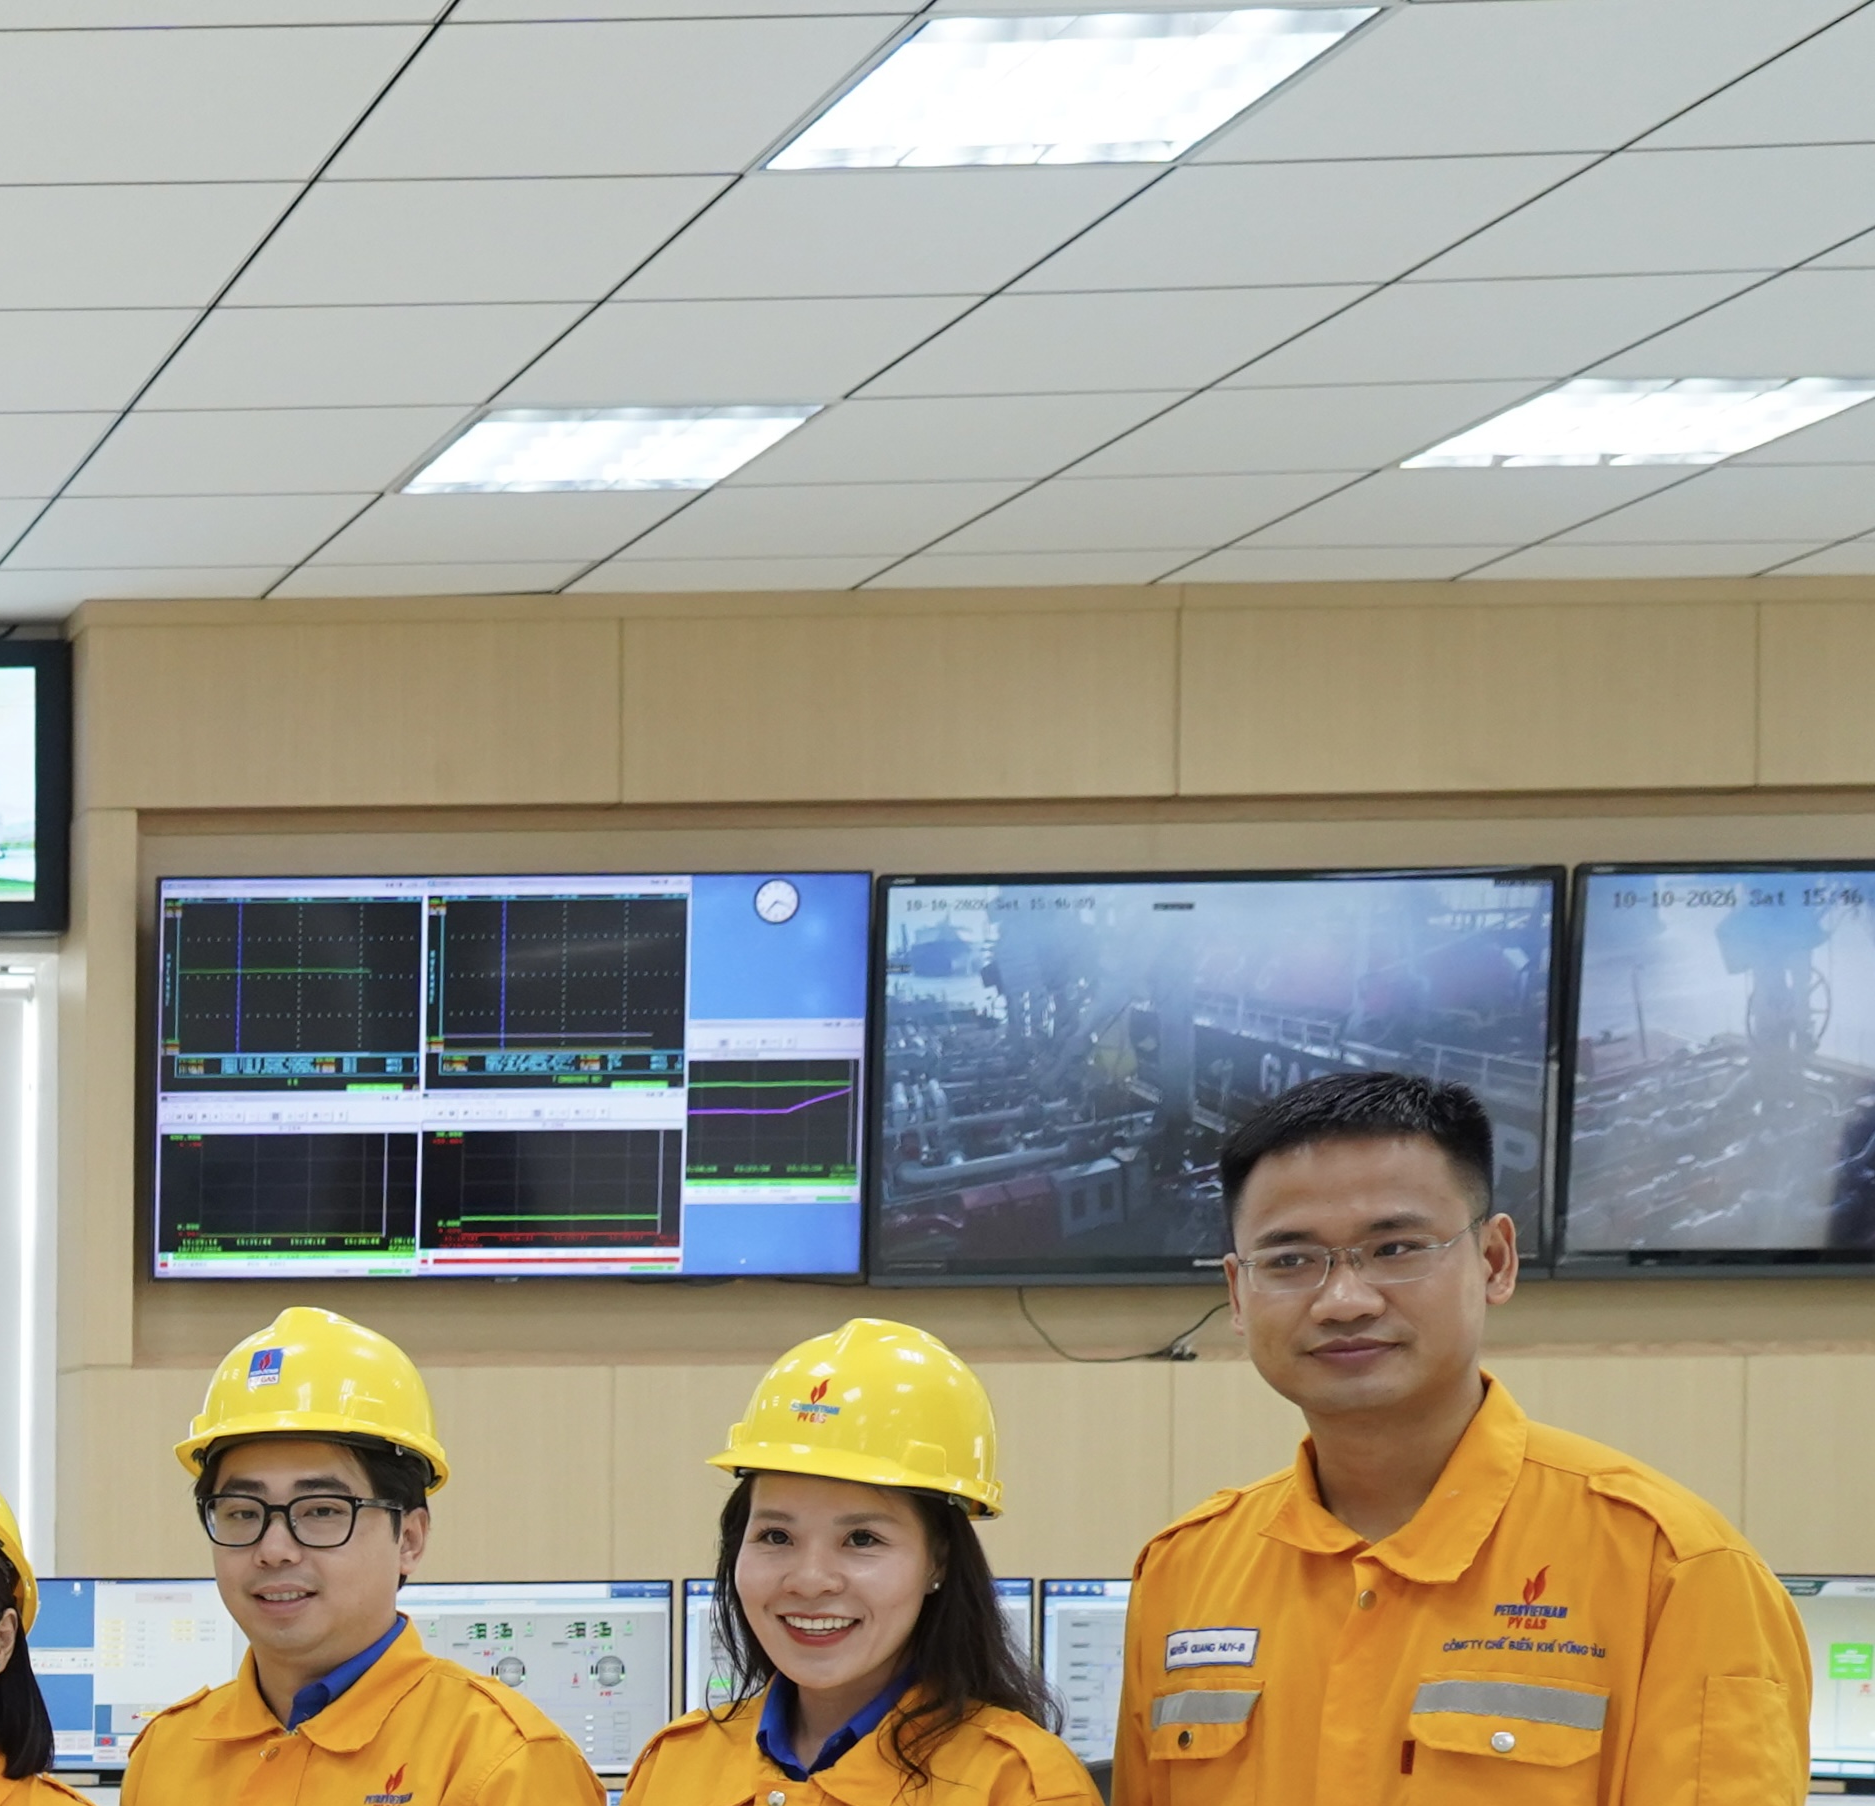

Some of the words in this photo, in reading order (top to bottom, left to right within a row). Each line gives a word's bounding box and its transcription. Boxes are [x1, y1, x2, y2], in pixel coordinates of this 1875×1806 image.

[797, 1411, 809, 1421] PV
[809, 1413, 828, 1424] GAS
[1506, 1617, 1523, 1629] PV
[1524, 1618, 1549, 1630] GAS
[1190, 1643, 1216, 1655] QUANG
[1535, 1639, 1557, 1653] KHÍ
